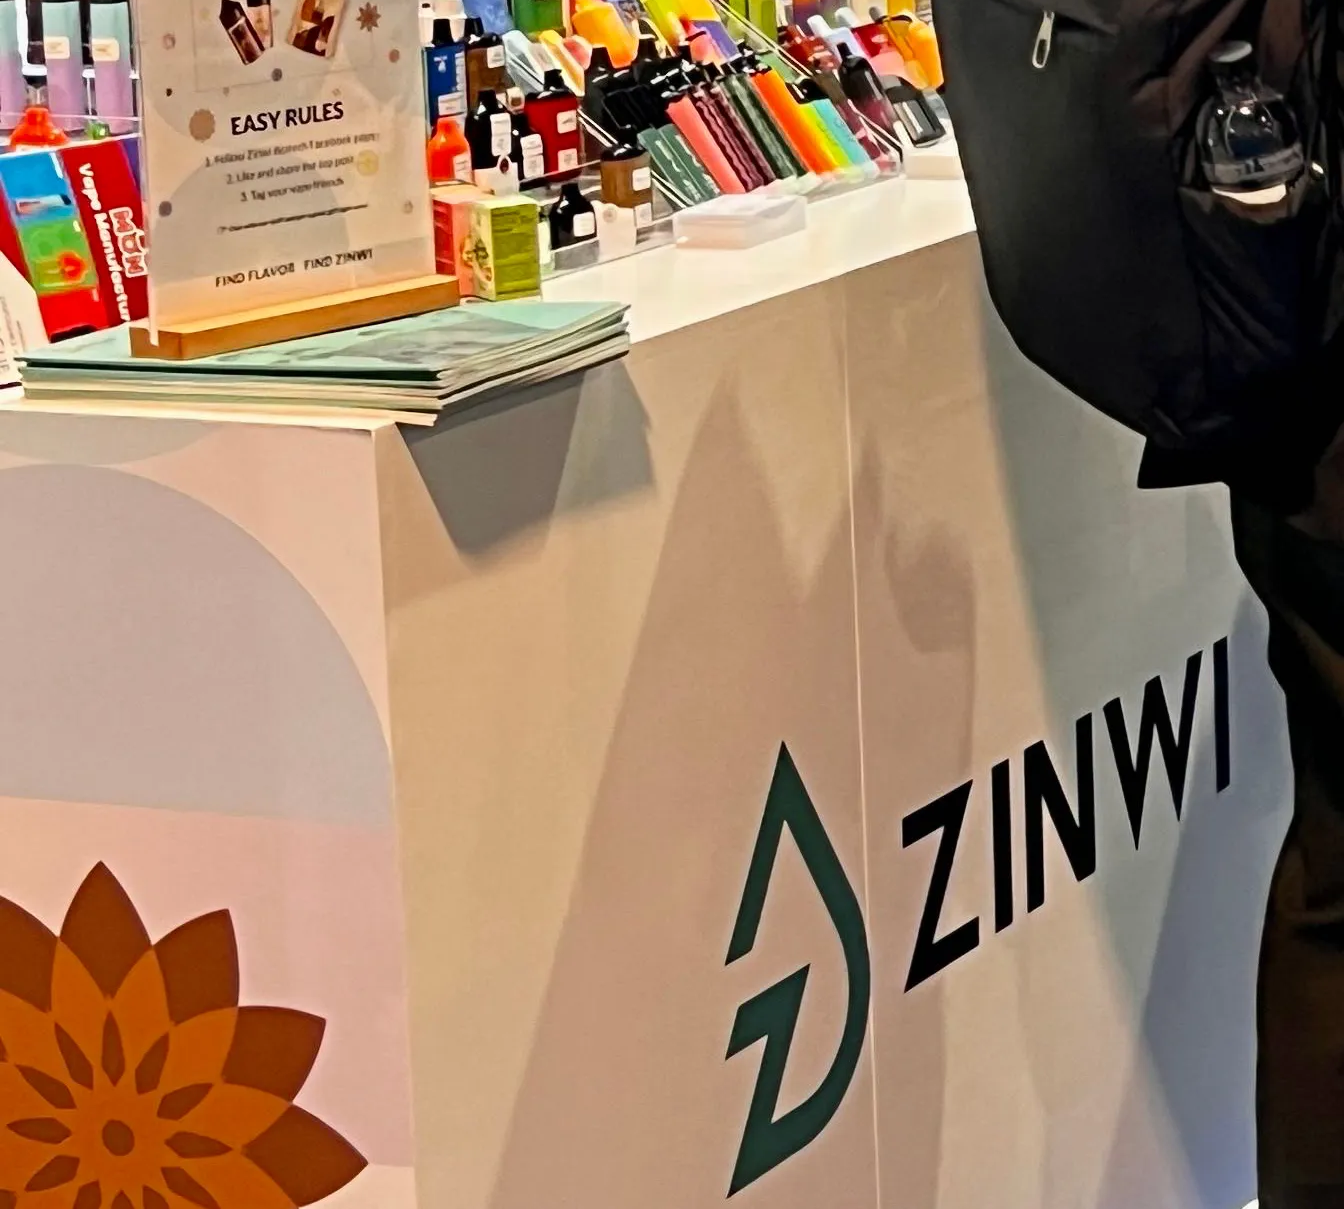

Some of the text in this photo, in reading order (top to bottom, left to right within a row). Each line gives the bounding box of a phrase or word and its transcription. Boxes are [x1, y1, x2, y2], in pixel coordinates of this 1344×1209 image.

[231, 101, 344, 136] EASY RULES
[902, 636, 1230, 993] ZINWI
